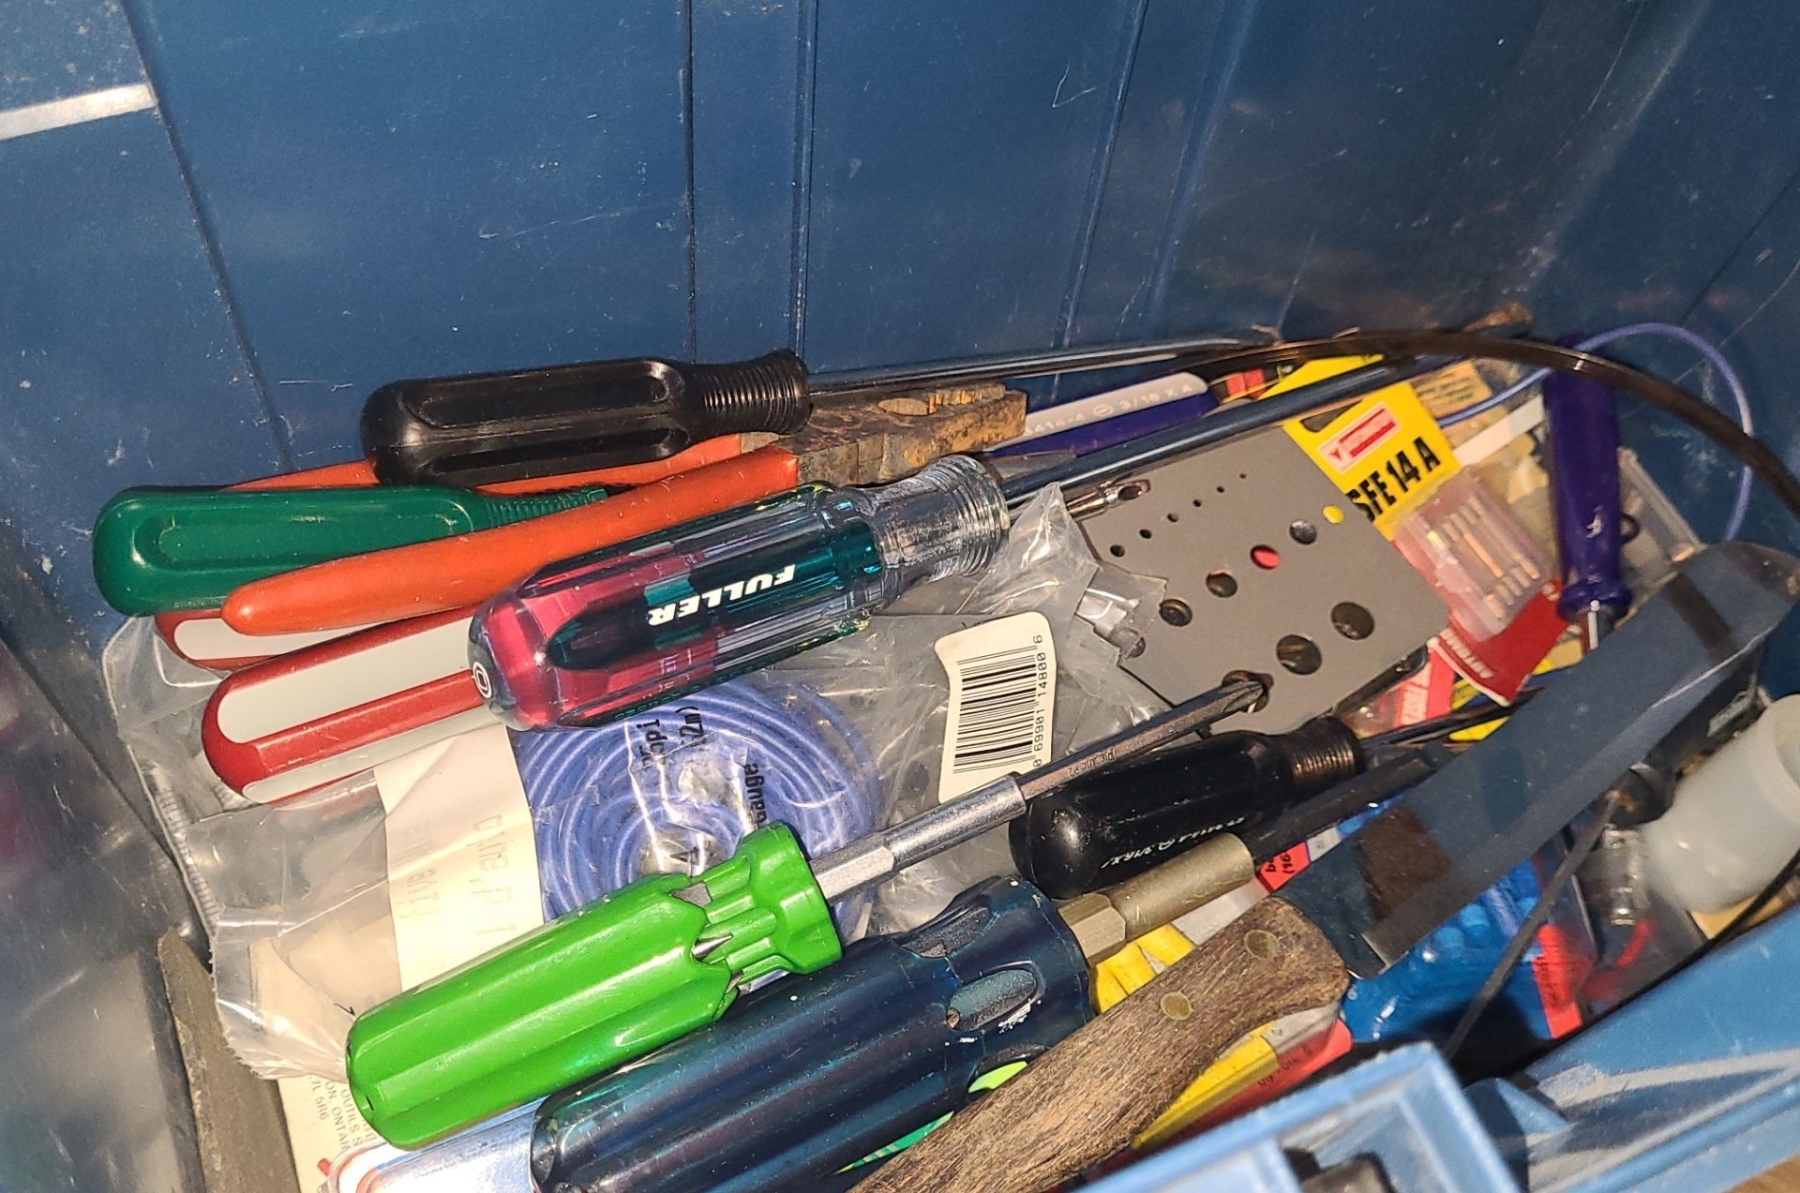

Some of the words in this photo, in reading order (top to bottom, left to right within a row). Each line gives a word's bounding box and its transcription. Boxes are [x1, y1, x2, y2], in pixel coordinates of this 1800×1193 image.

[1345, 471, 1397, 523] SFE
[648, 564, 796, 626] FULLER
[315, 1096, 329, 1120] 5R6
[341, 1088, 360, 1133] OUTILS
